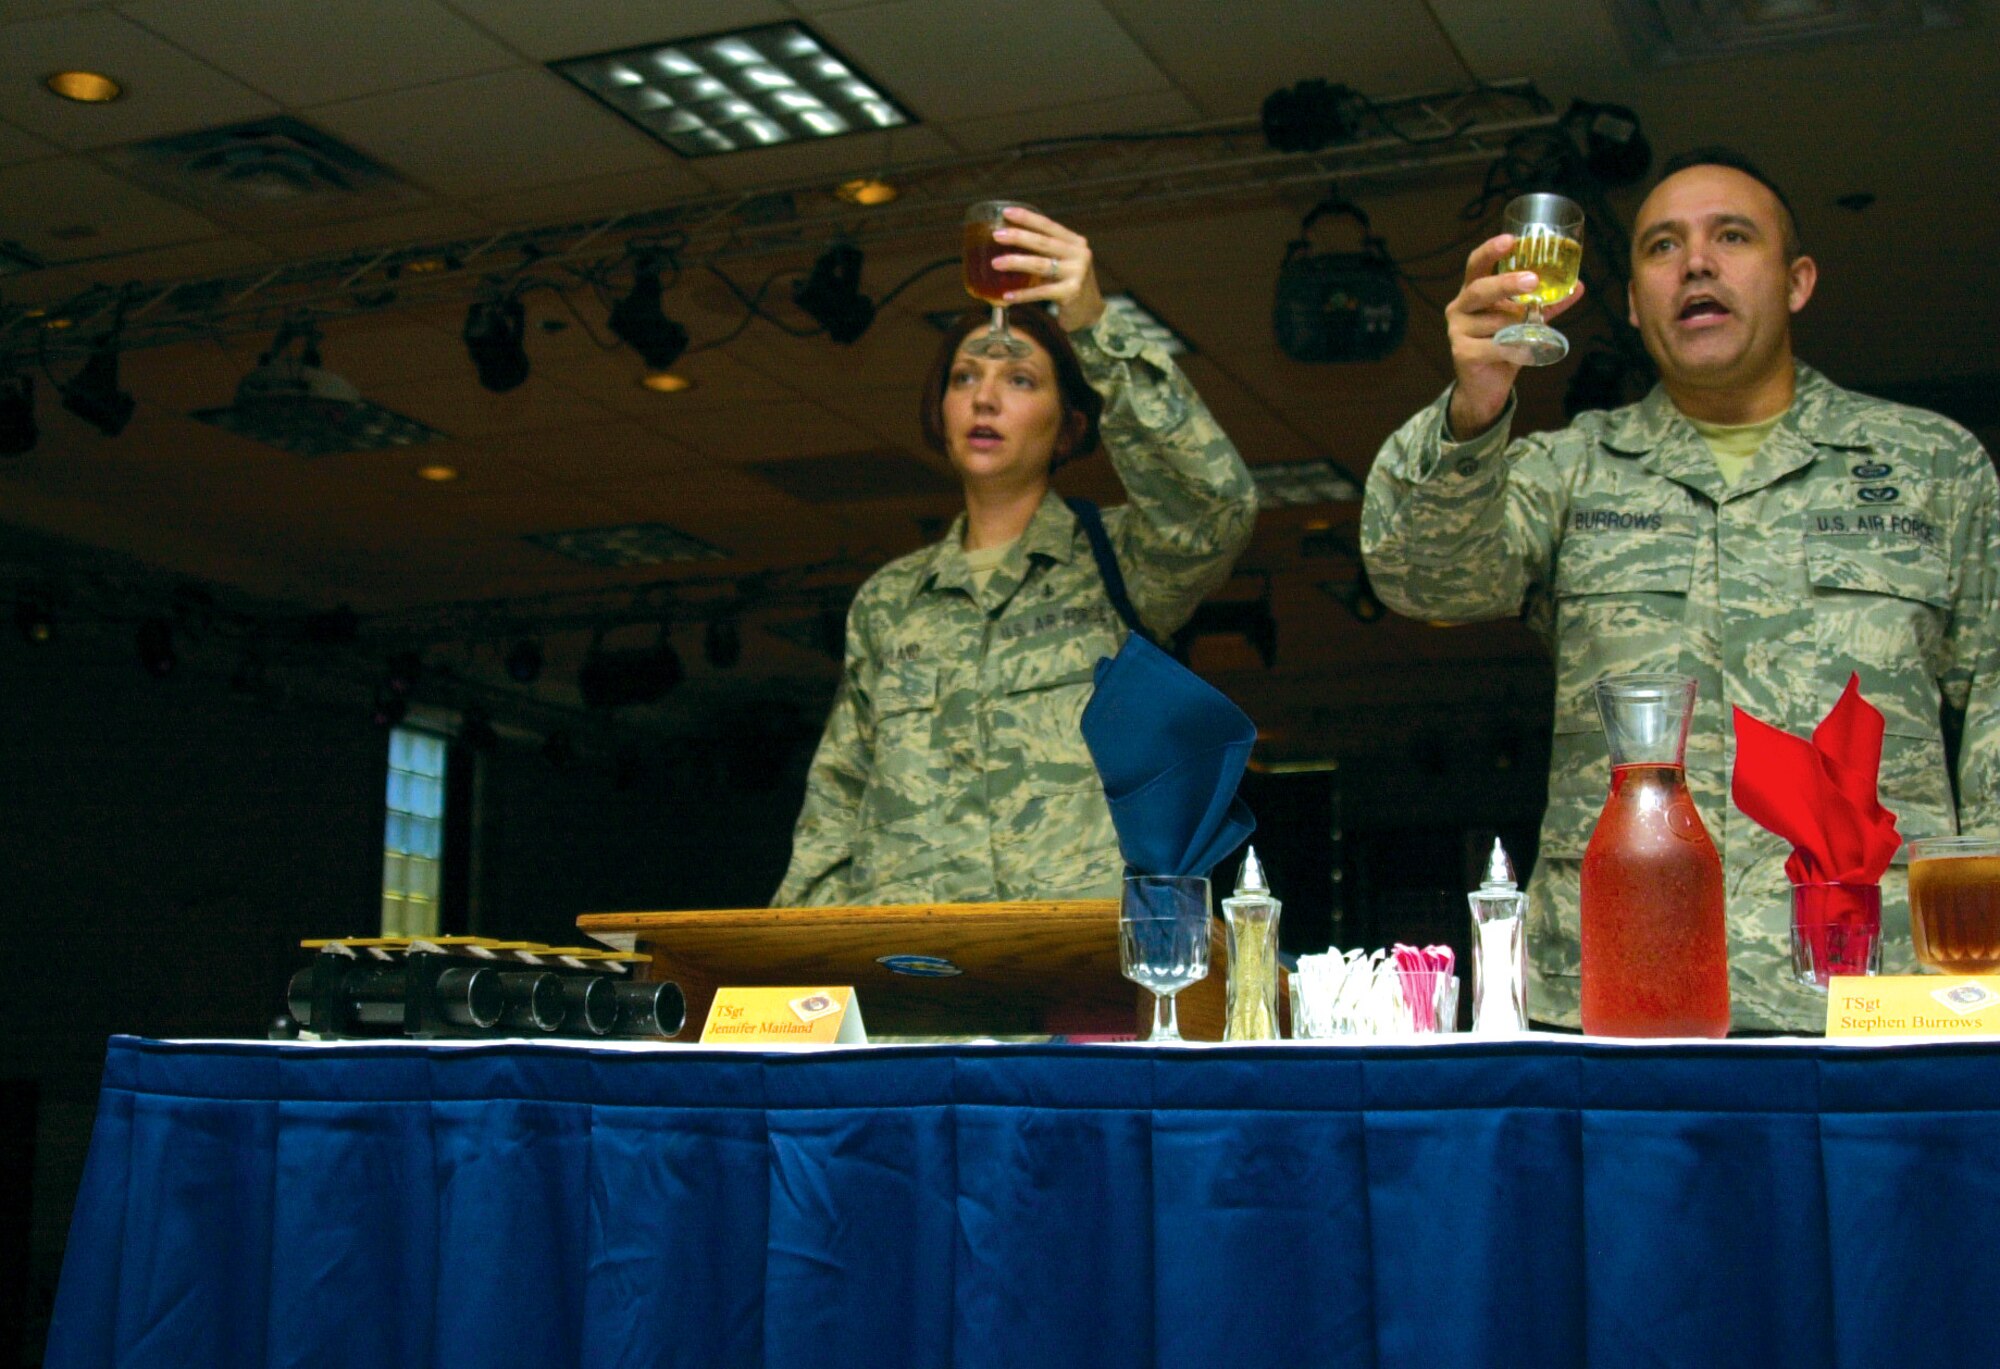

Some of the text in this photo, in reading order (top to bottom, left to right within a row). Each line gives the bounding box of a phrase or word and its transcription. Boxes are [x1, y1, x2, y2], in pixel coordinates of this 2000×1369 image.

[1575, 511, 1662, 531] BURROWS
[1816, 515, 1850, 532] U.S.
[1858, 514, 1884, 532] AIR
[716, 1005, 744, 1019] TSgt
[1842, 997, 1880, 1013] TSgt
[709, 1022, 814, 1035] Jennifer Maitland
[1841, 1016, 1983, 1032] Stephen Burrows
